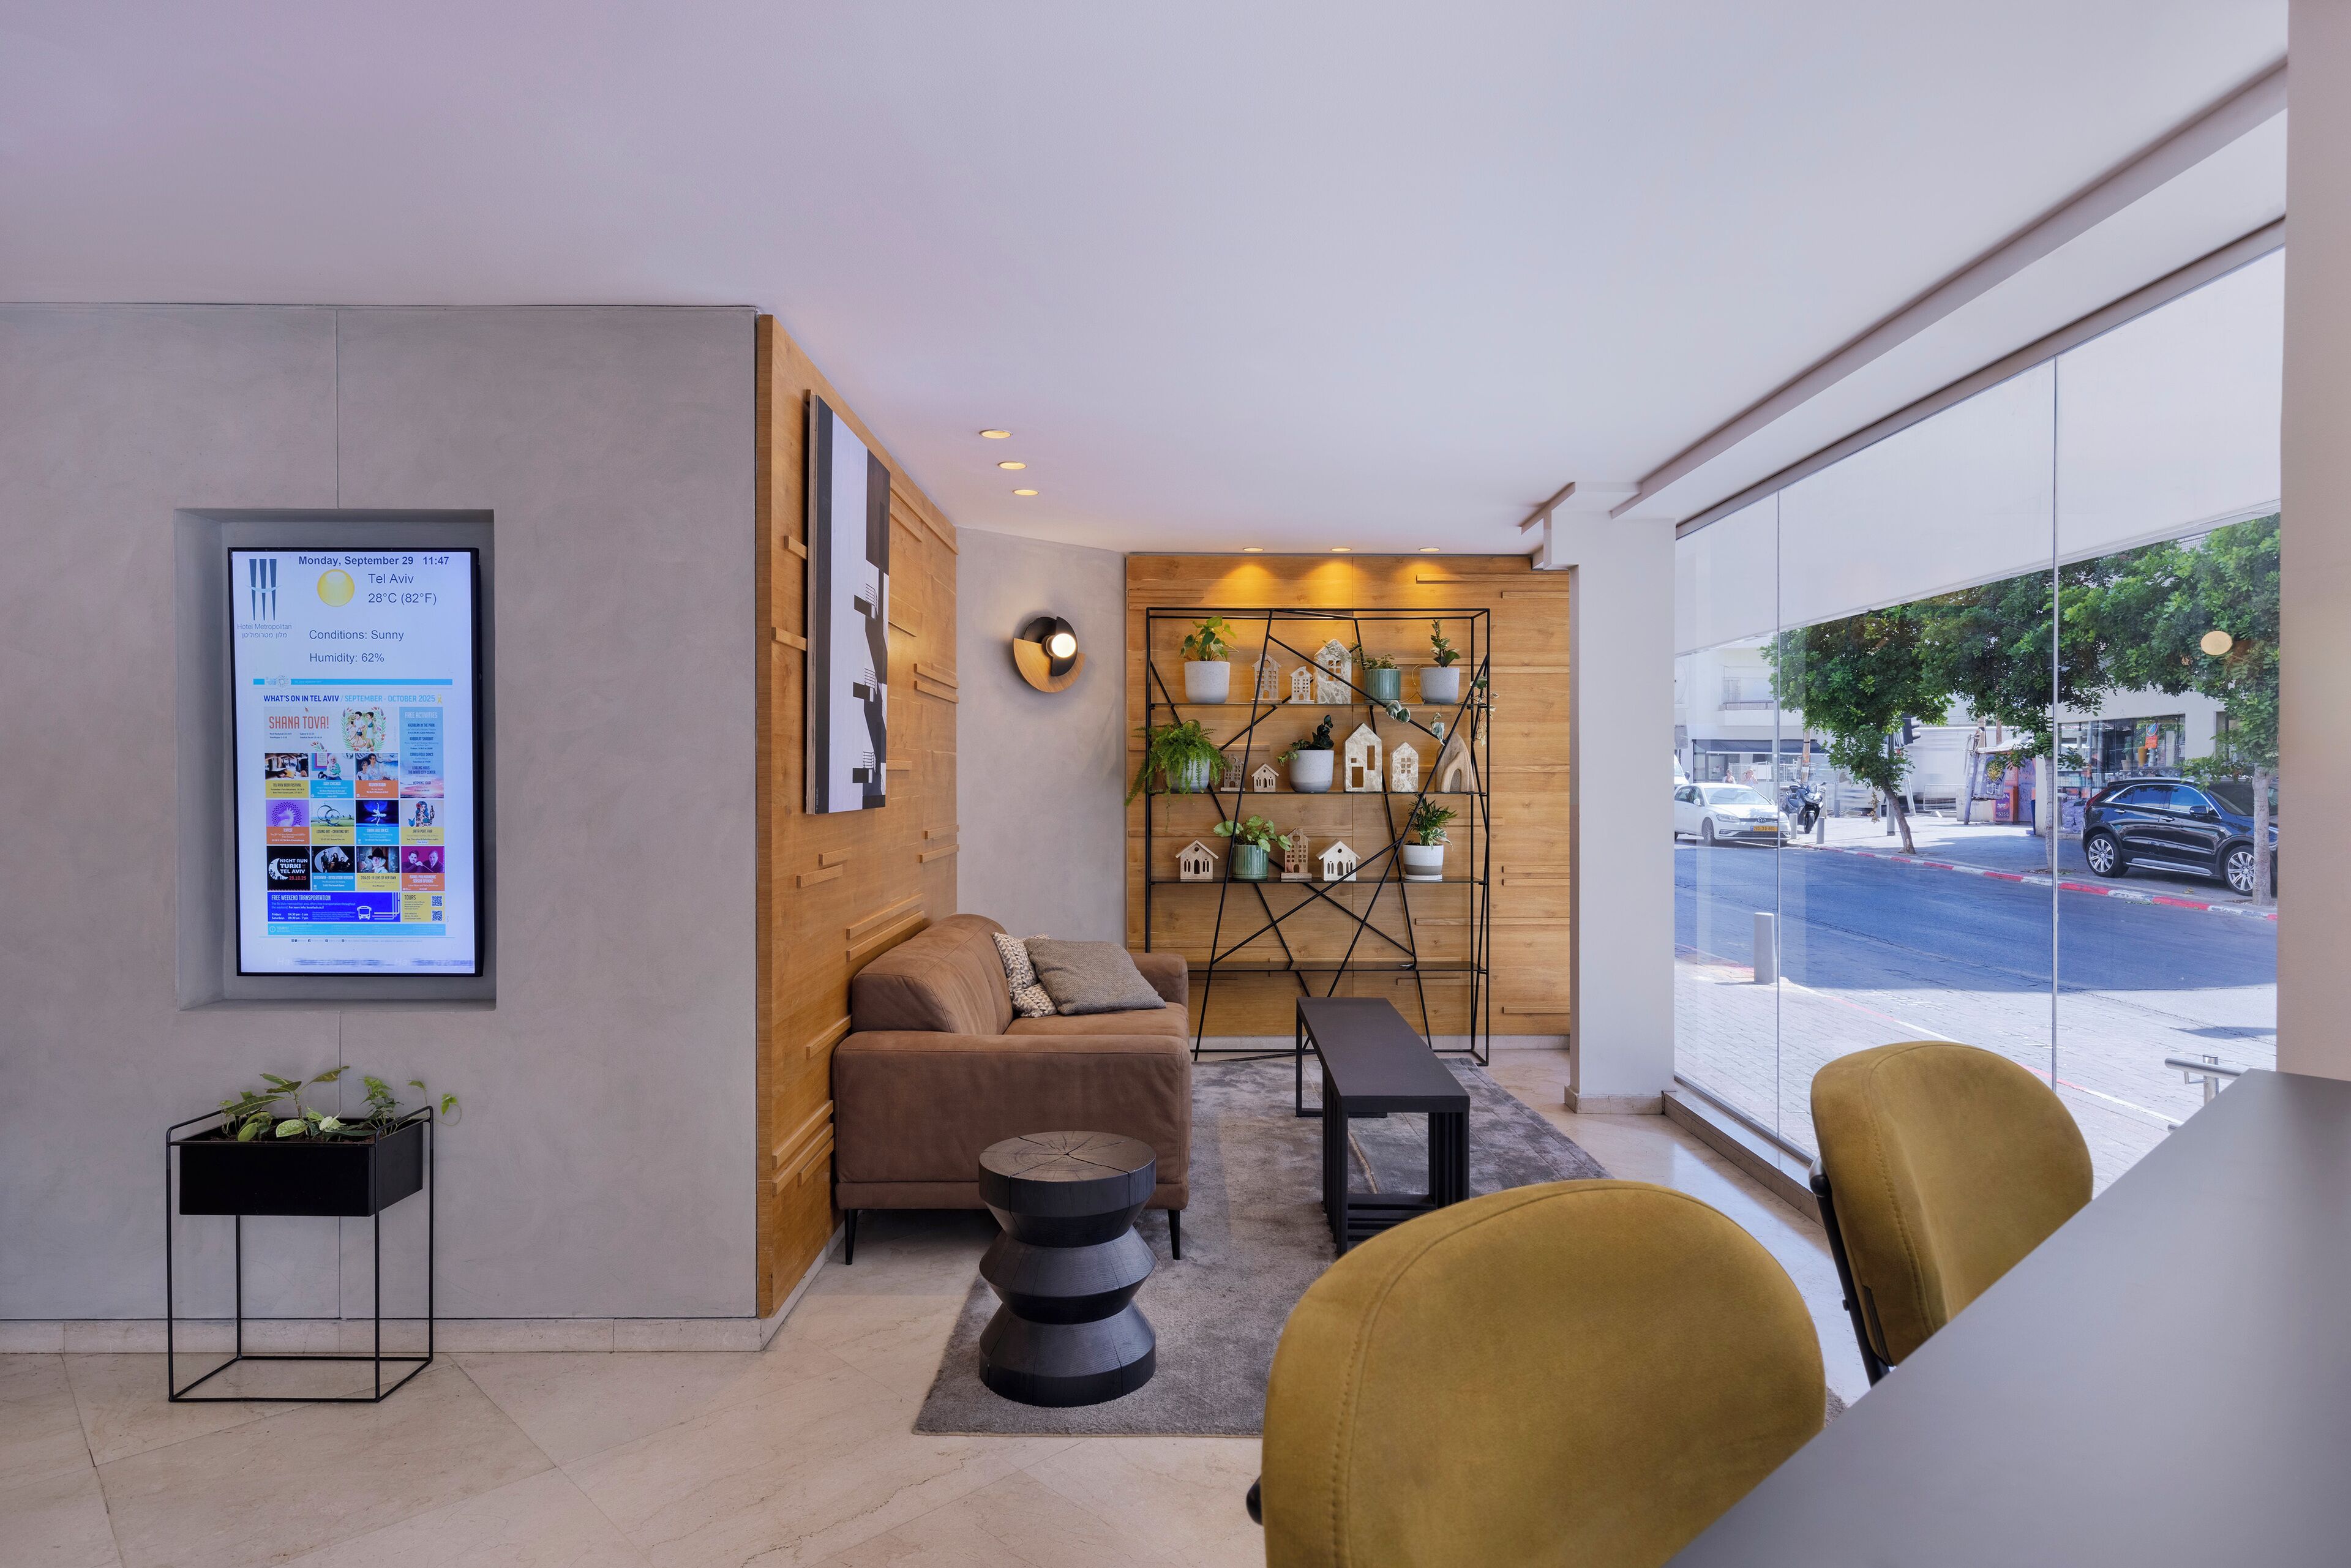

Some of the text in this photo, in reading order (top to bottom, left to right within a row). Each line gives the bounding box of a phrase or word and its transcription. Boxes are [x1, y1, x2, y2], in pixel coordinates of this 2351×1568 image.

[299, 556, 414, 566] Monday, September 29
[422, 557, 449, 565] 11:47
[368, 573, 414, 583] Tel Aviv
[368, 593, 437, 606] 28°C (82°F)
[309, 629, 404, 642] Conditions: Sunny
[310, 653, 384, 664] Humidity: 62%
[269, 716, 329, 729] SHANA TOVA!
